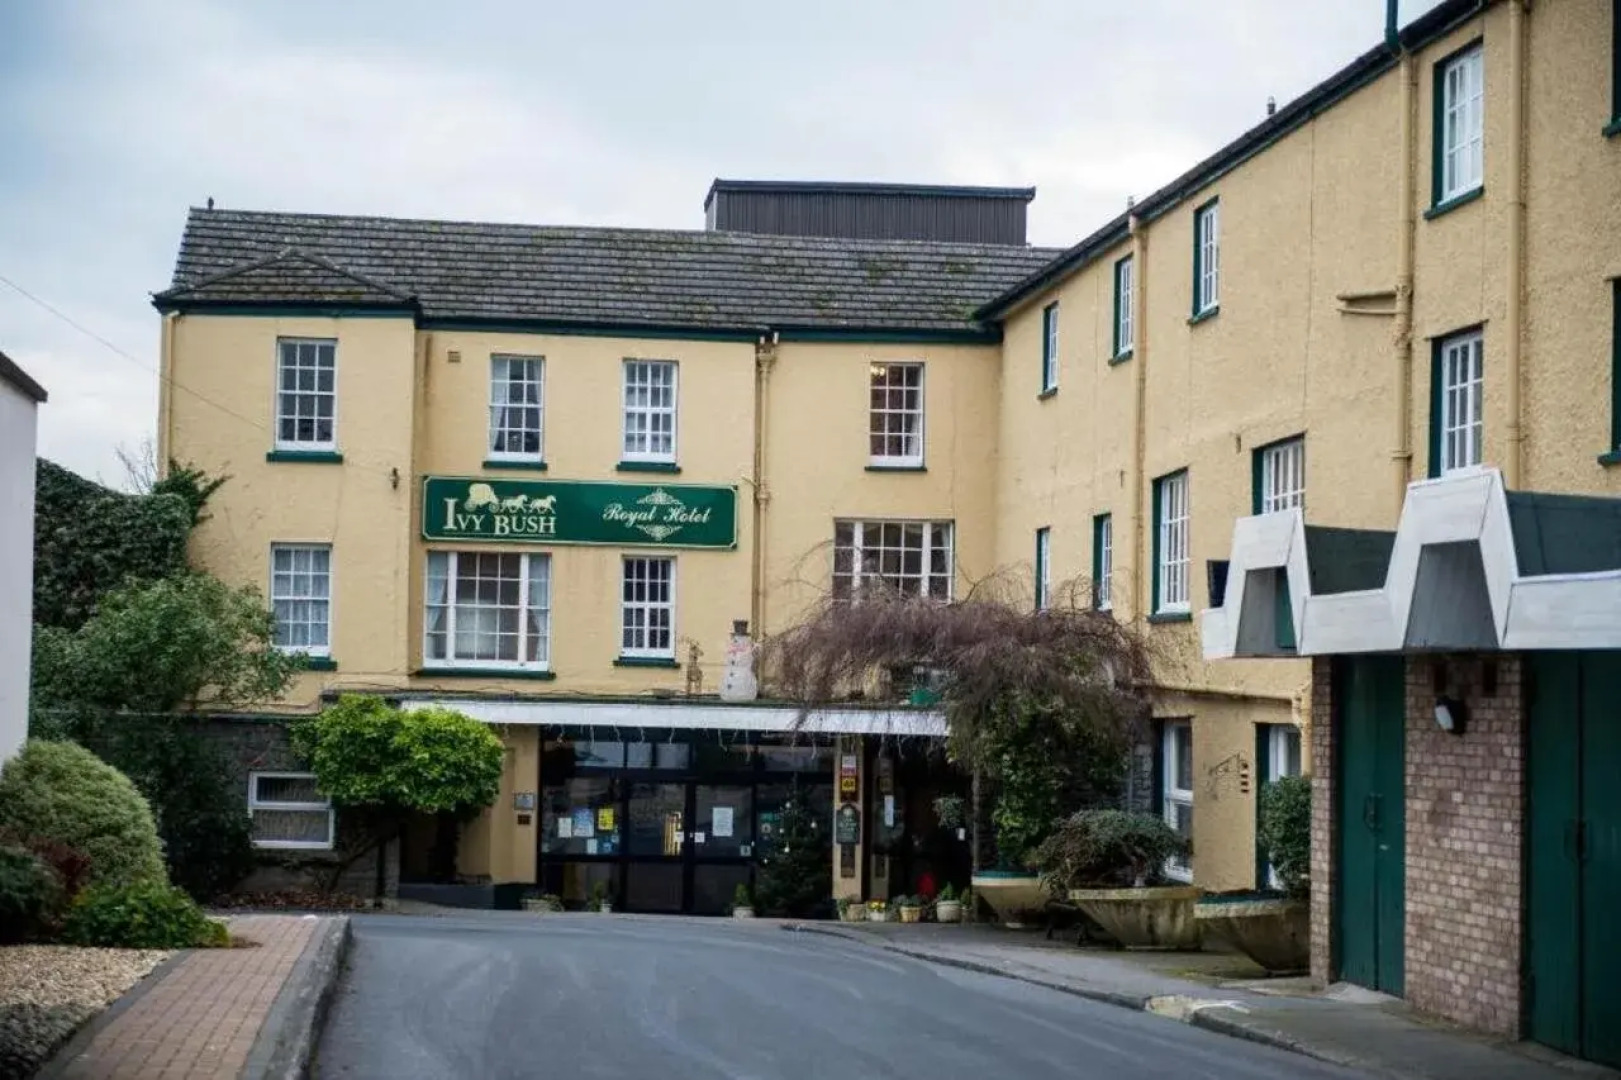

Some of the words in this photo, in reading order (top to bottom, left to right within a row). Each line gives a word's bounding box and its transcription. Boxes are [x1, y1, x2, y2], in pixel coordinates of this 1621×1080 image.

[442, 498, 485, 531] IVY
[493, 514, 557, 535] BUSH
[602, 503, 657, 528] Royal
[663, 504, 712, 523] Hotel
